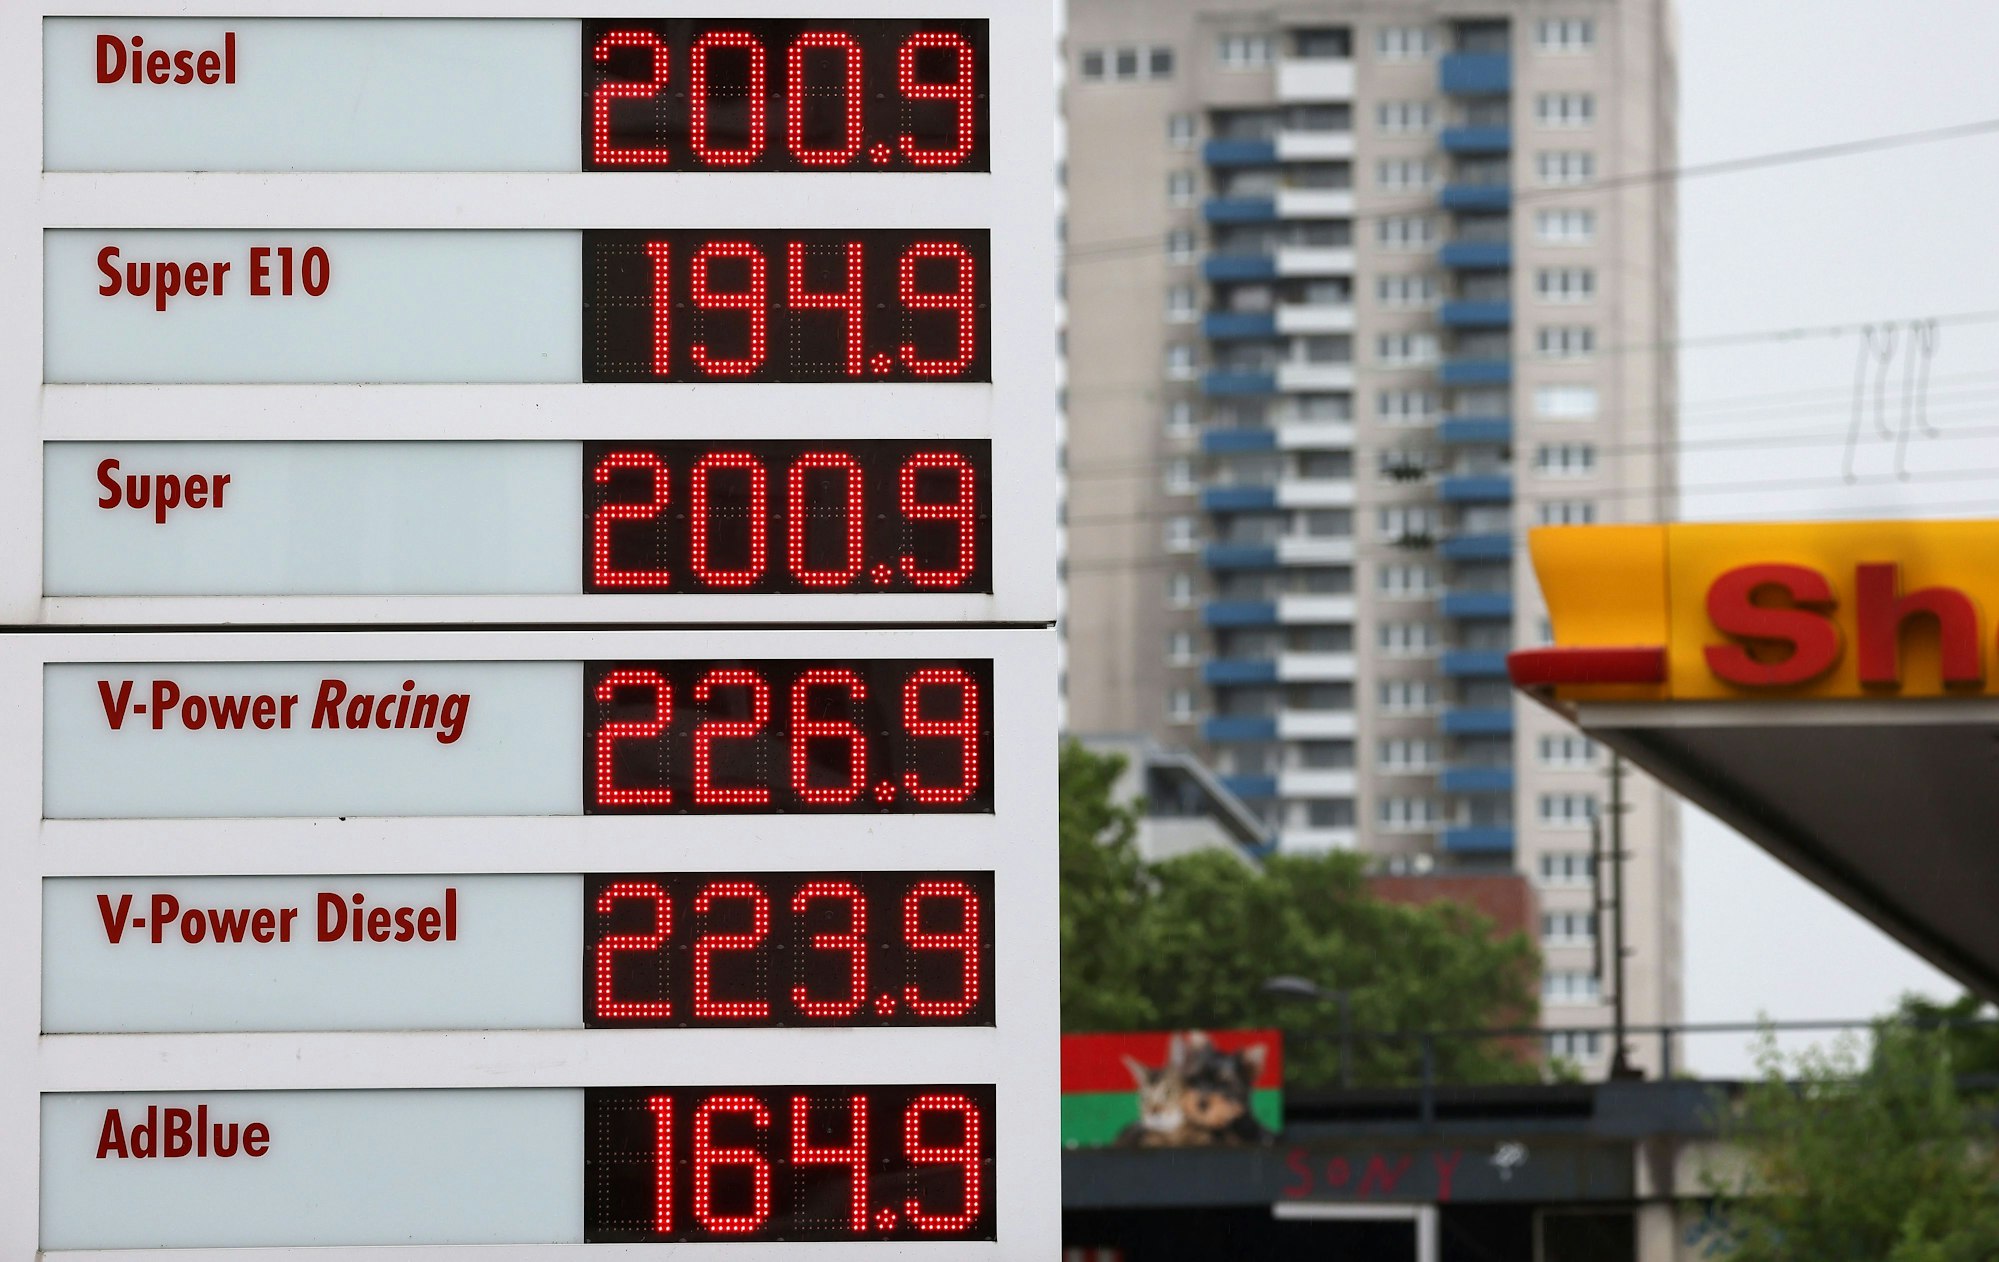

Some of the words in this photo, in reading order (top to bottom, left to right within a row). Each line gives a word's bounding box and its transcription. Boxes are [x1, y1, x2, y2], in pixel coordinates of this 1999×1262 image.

[96, 32, 237, 85] Diesel
[594, 31, 974, 166] 200.9
[97, 246, 232, 311] Super
[250, 246, 331, 297] E10
[646, 241, 975, 376] 194.9
[97, 459, 230, 525] Super
[594, 452, 975, 587] 200.9
[1704, 562, 1999, 690] Sh
[97, 681, 299, 730] V-Power
[311, 679, 470, 744] Racing
[595, 670, 979, 806] 226.9
[97, 893, 297, 945] V-Power
[317, 888, 458, 943] Diesel
[596, 881, 980, 1018] 223.9
[96, 1106, 270, 1159] AdBlue
[645, 1094, 981, 1233] 164.9
